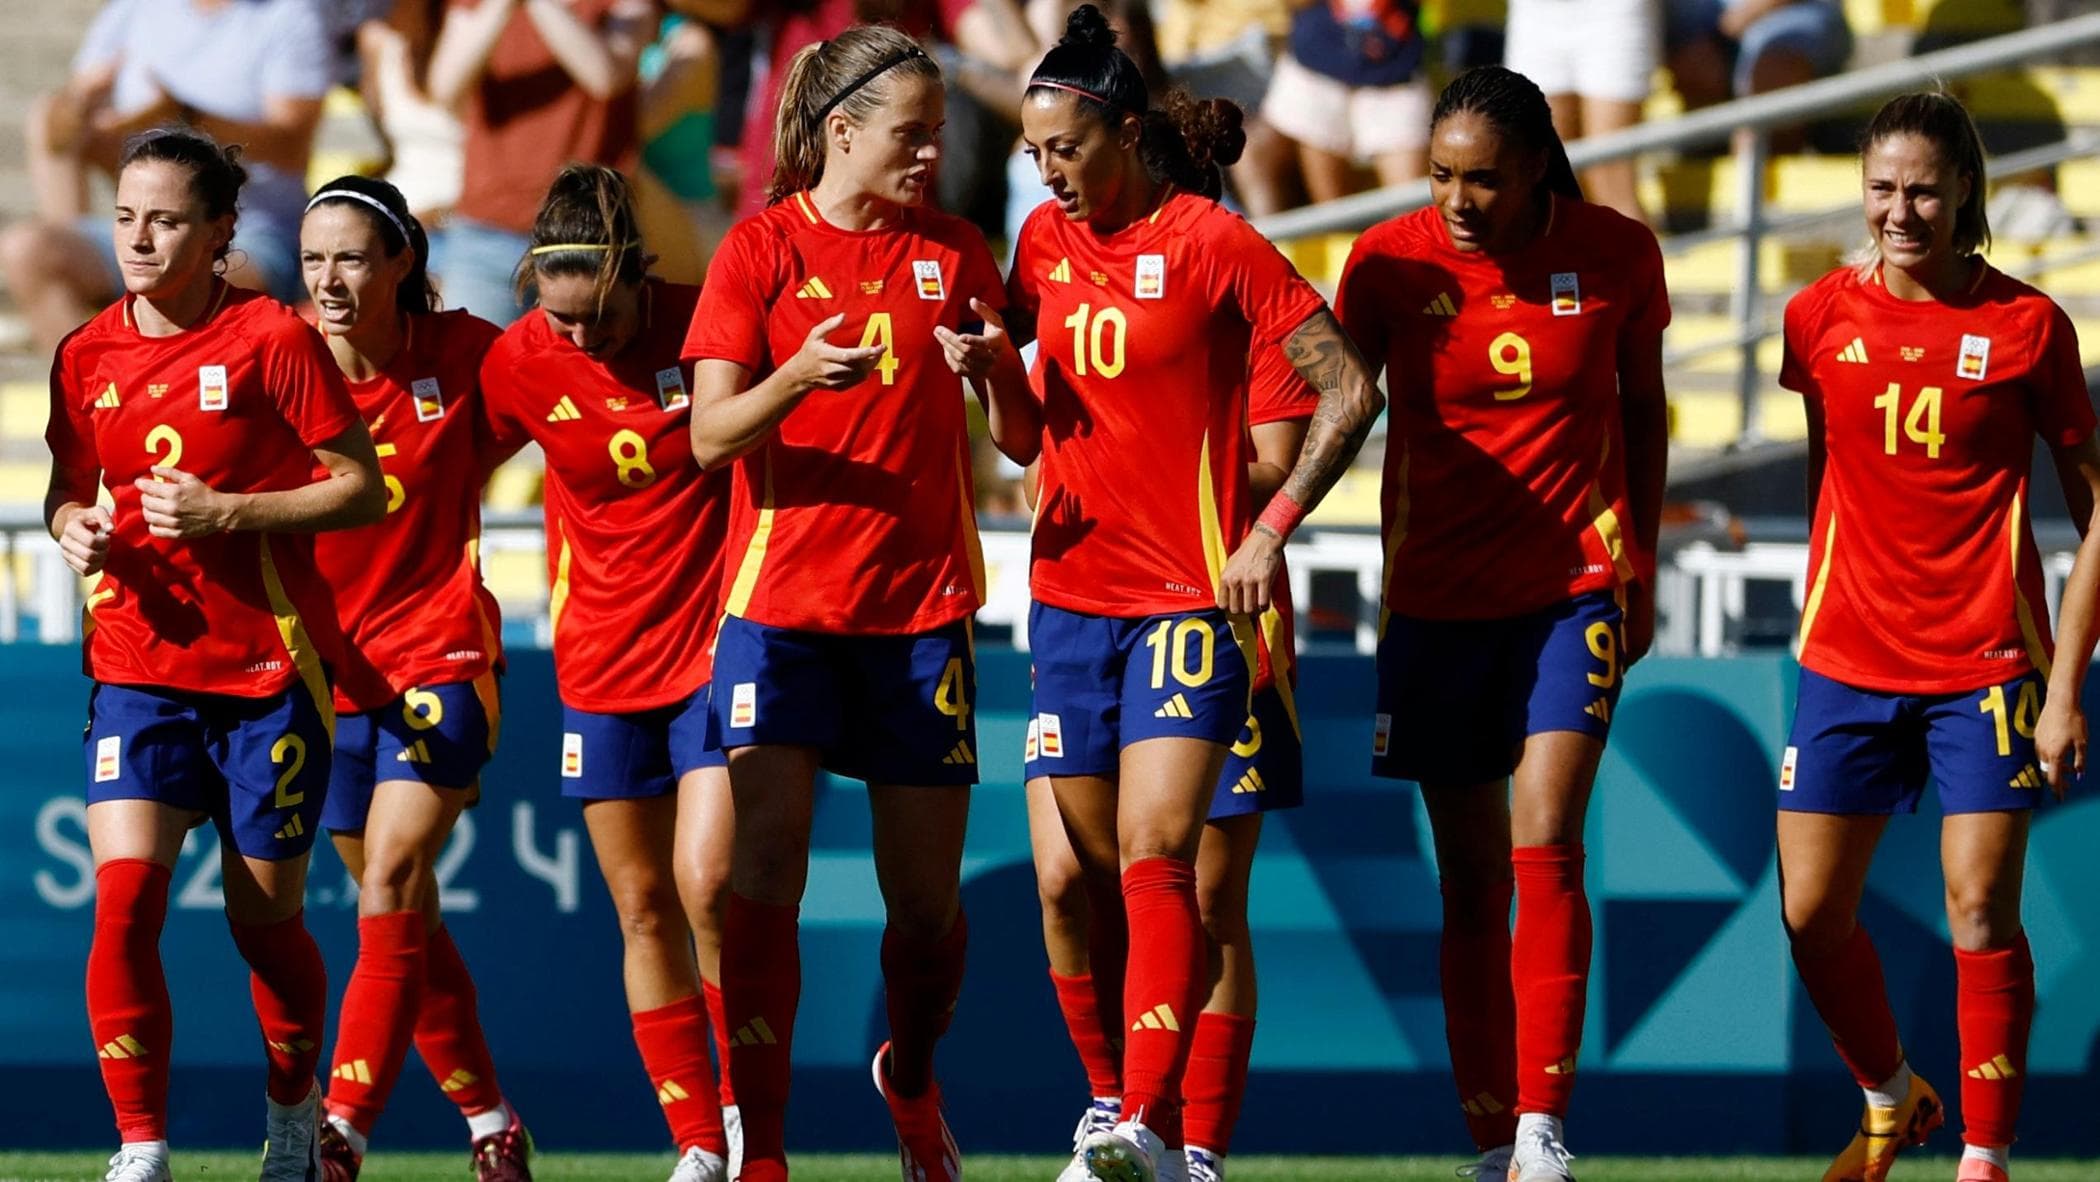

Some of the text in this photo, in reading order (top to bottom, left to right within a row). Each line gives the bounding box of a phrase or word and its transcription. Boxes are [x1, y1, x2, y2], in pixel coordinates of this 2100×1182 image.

[856, 312, 898, 385] 4
[1064, 303, 1127, 379] 10
[1488, 332, 1532, 401] 9
[143, 424, 183, 486] 2
[1873, 382, 1944, 459] 14
[608, 429, 654, 488] 8
[1145, 617, 1214, 688] 10
[1584, 621, 1615, 688] 9
[402, 687, 442, 730] 6
[933, 657, 967, 730] 4
[1979, 681, 2038, 756] 14
[271, 733, 305, 808] 2
